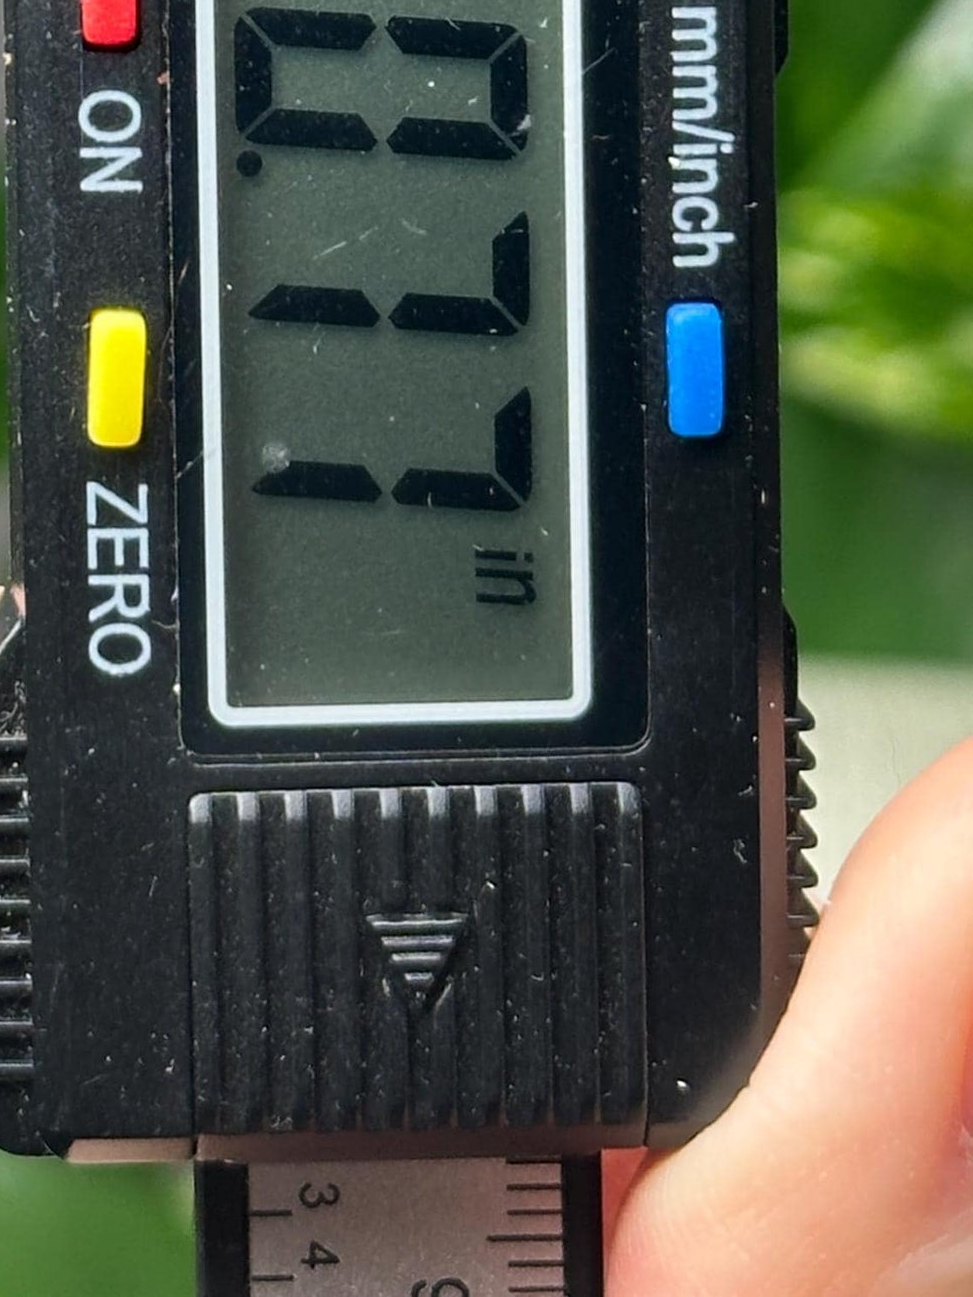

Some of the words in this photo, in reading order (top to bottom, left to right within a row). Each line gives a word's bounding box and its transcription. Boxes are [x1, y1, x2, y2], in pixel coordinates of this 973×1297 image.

[77, 90, 142, 194] ON
[670, 4, 736, 269] mm/inch
[233, 5, 532, 511] 0.77
[473, 548, 535, 606] in
[85, 481, 152, 678] ZERO
[298, 1181, 342, 1209] 3
[299, 1239, 341, 1270] 4
